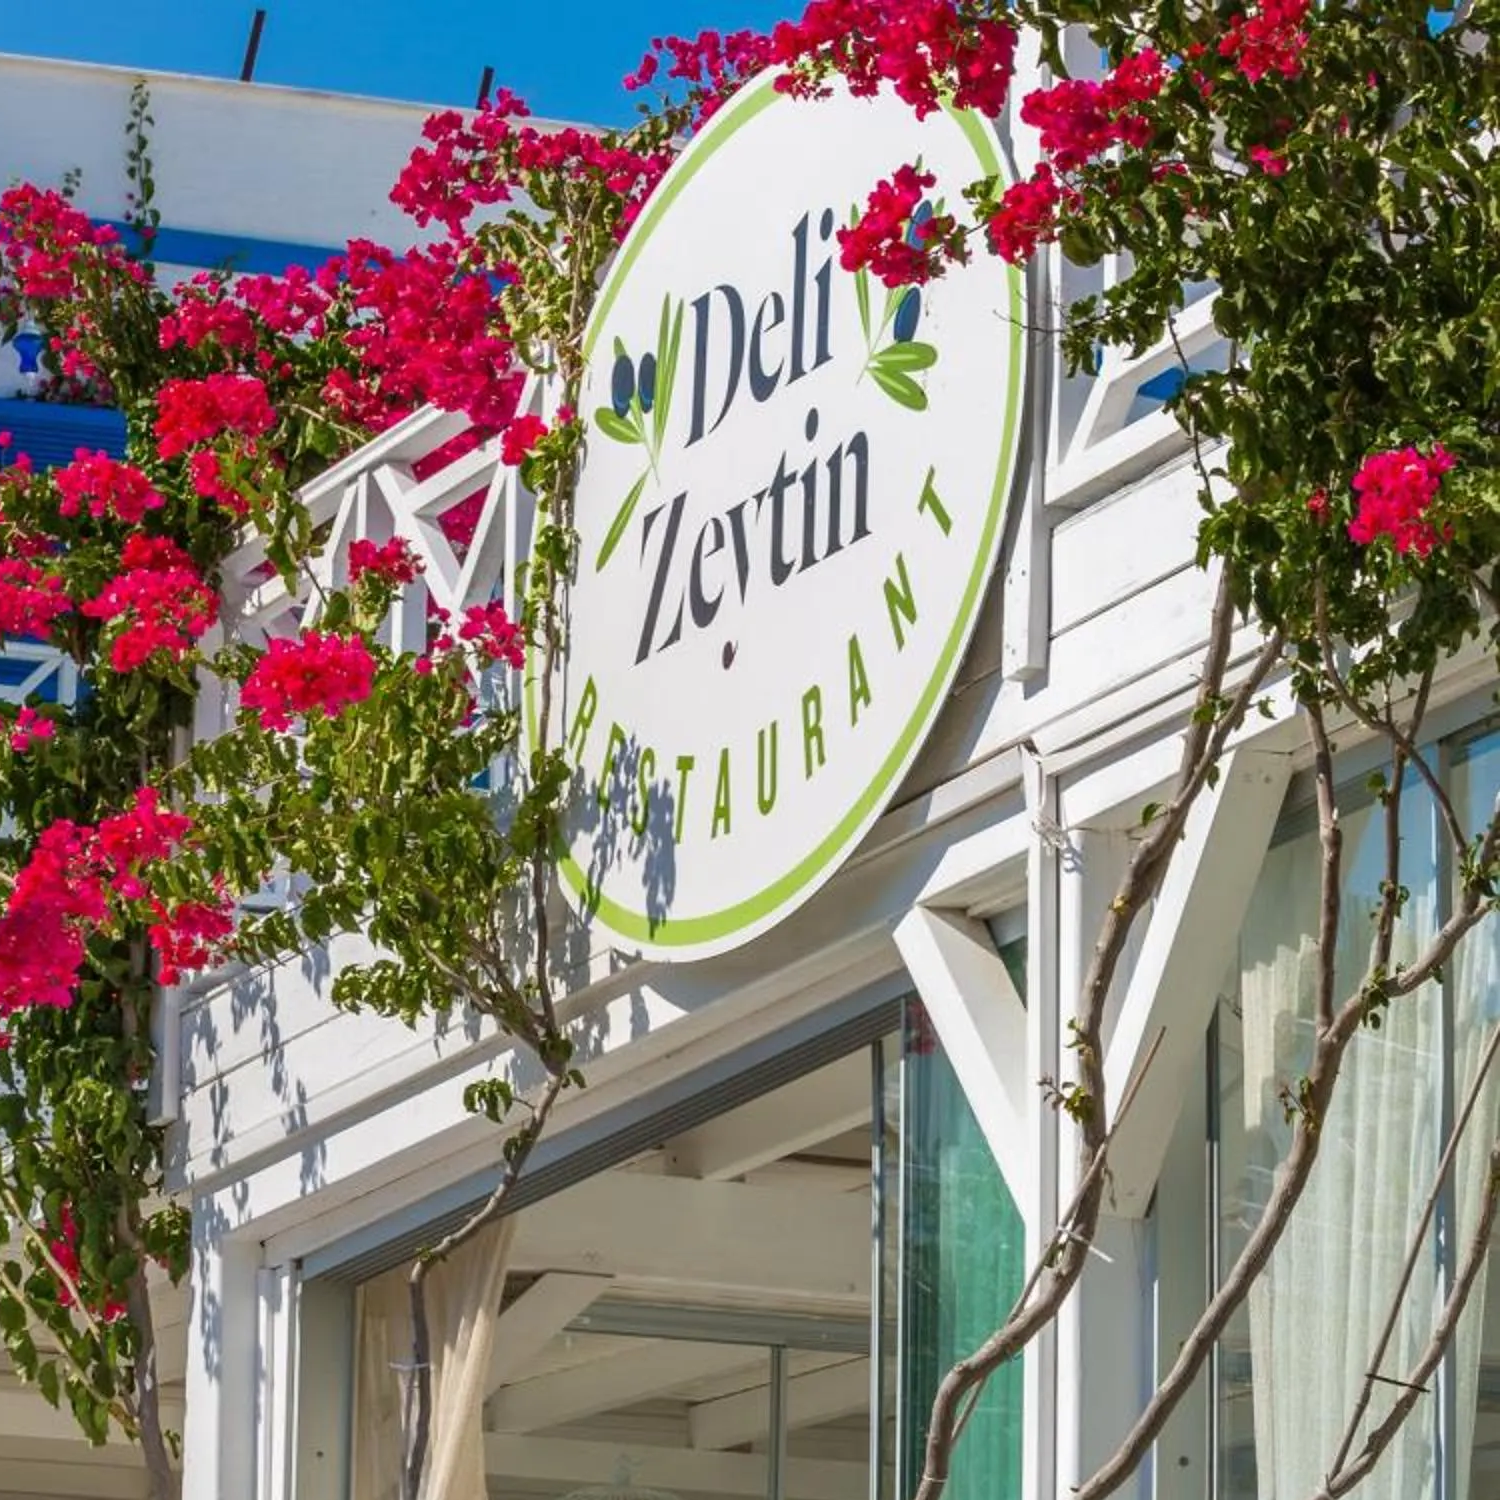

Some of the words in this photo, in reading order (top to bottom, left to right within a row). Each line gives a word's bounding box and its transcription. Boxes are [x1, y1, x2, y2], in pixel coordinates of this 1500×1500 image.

[684, 206, 836, 449] Deli
[568, 466, 954, 845] RESTAURANT
[633, 407, 872, 670] Zeytin
